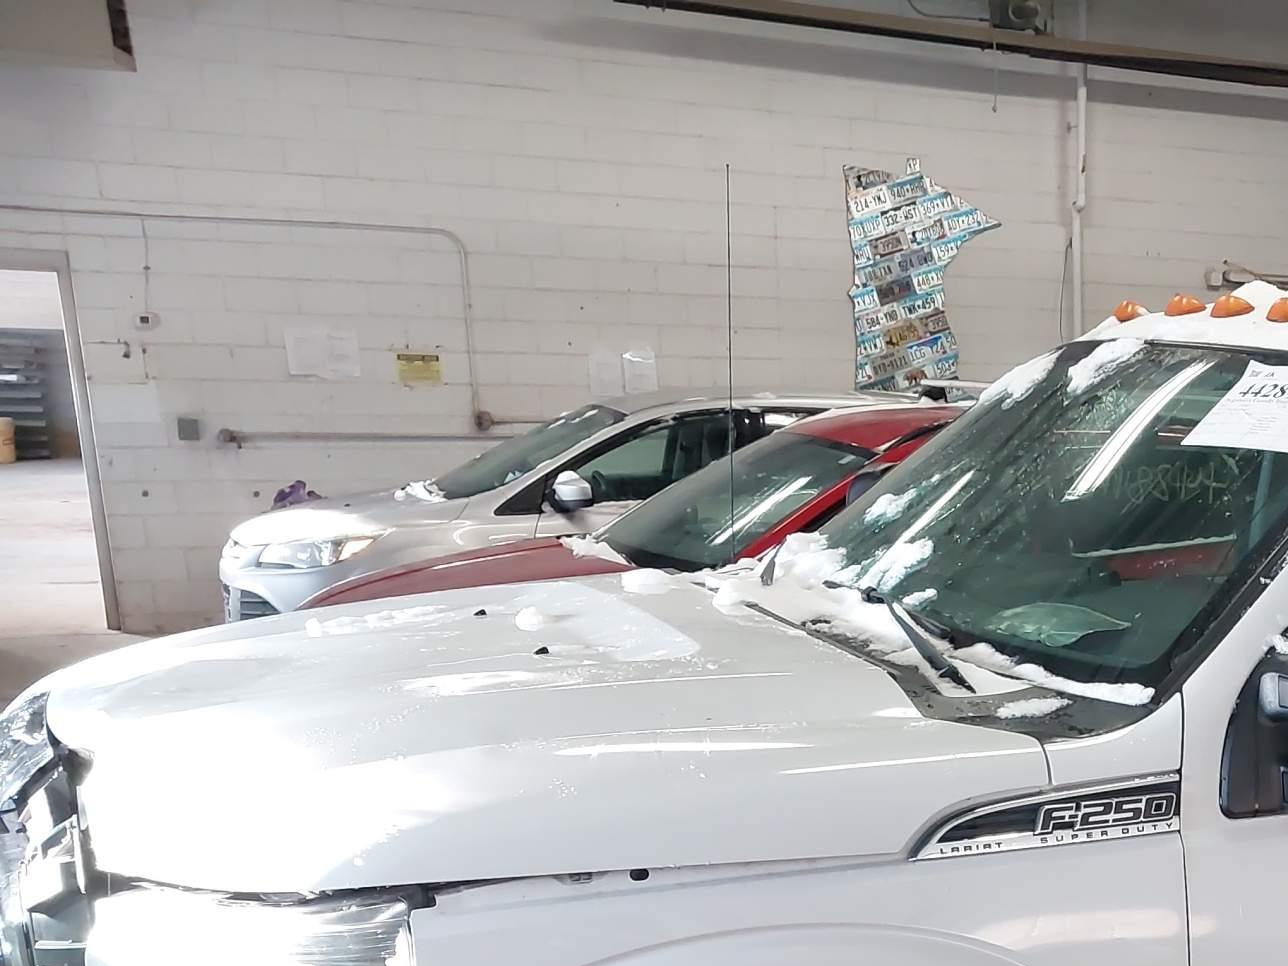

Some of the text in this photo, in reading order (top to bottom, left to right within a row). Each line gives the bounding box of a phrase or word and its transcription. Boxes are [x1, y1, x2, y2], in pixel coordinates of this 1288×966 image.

[1034, 794, 1177, 836] F-250
[939, 821, 1174, 855] LARIAT SUPER DUTY
